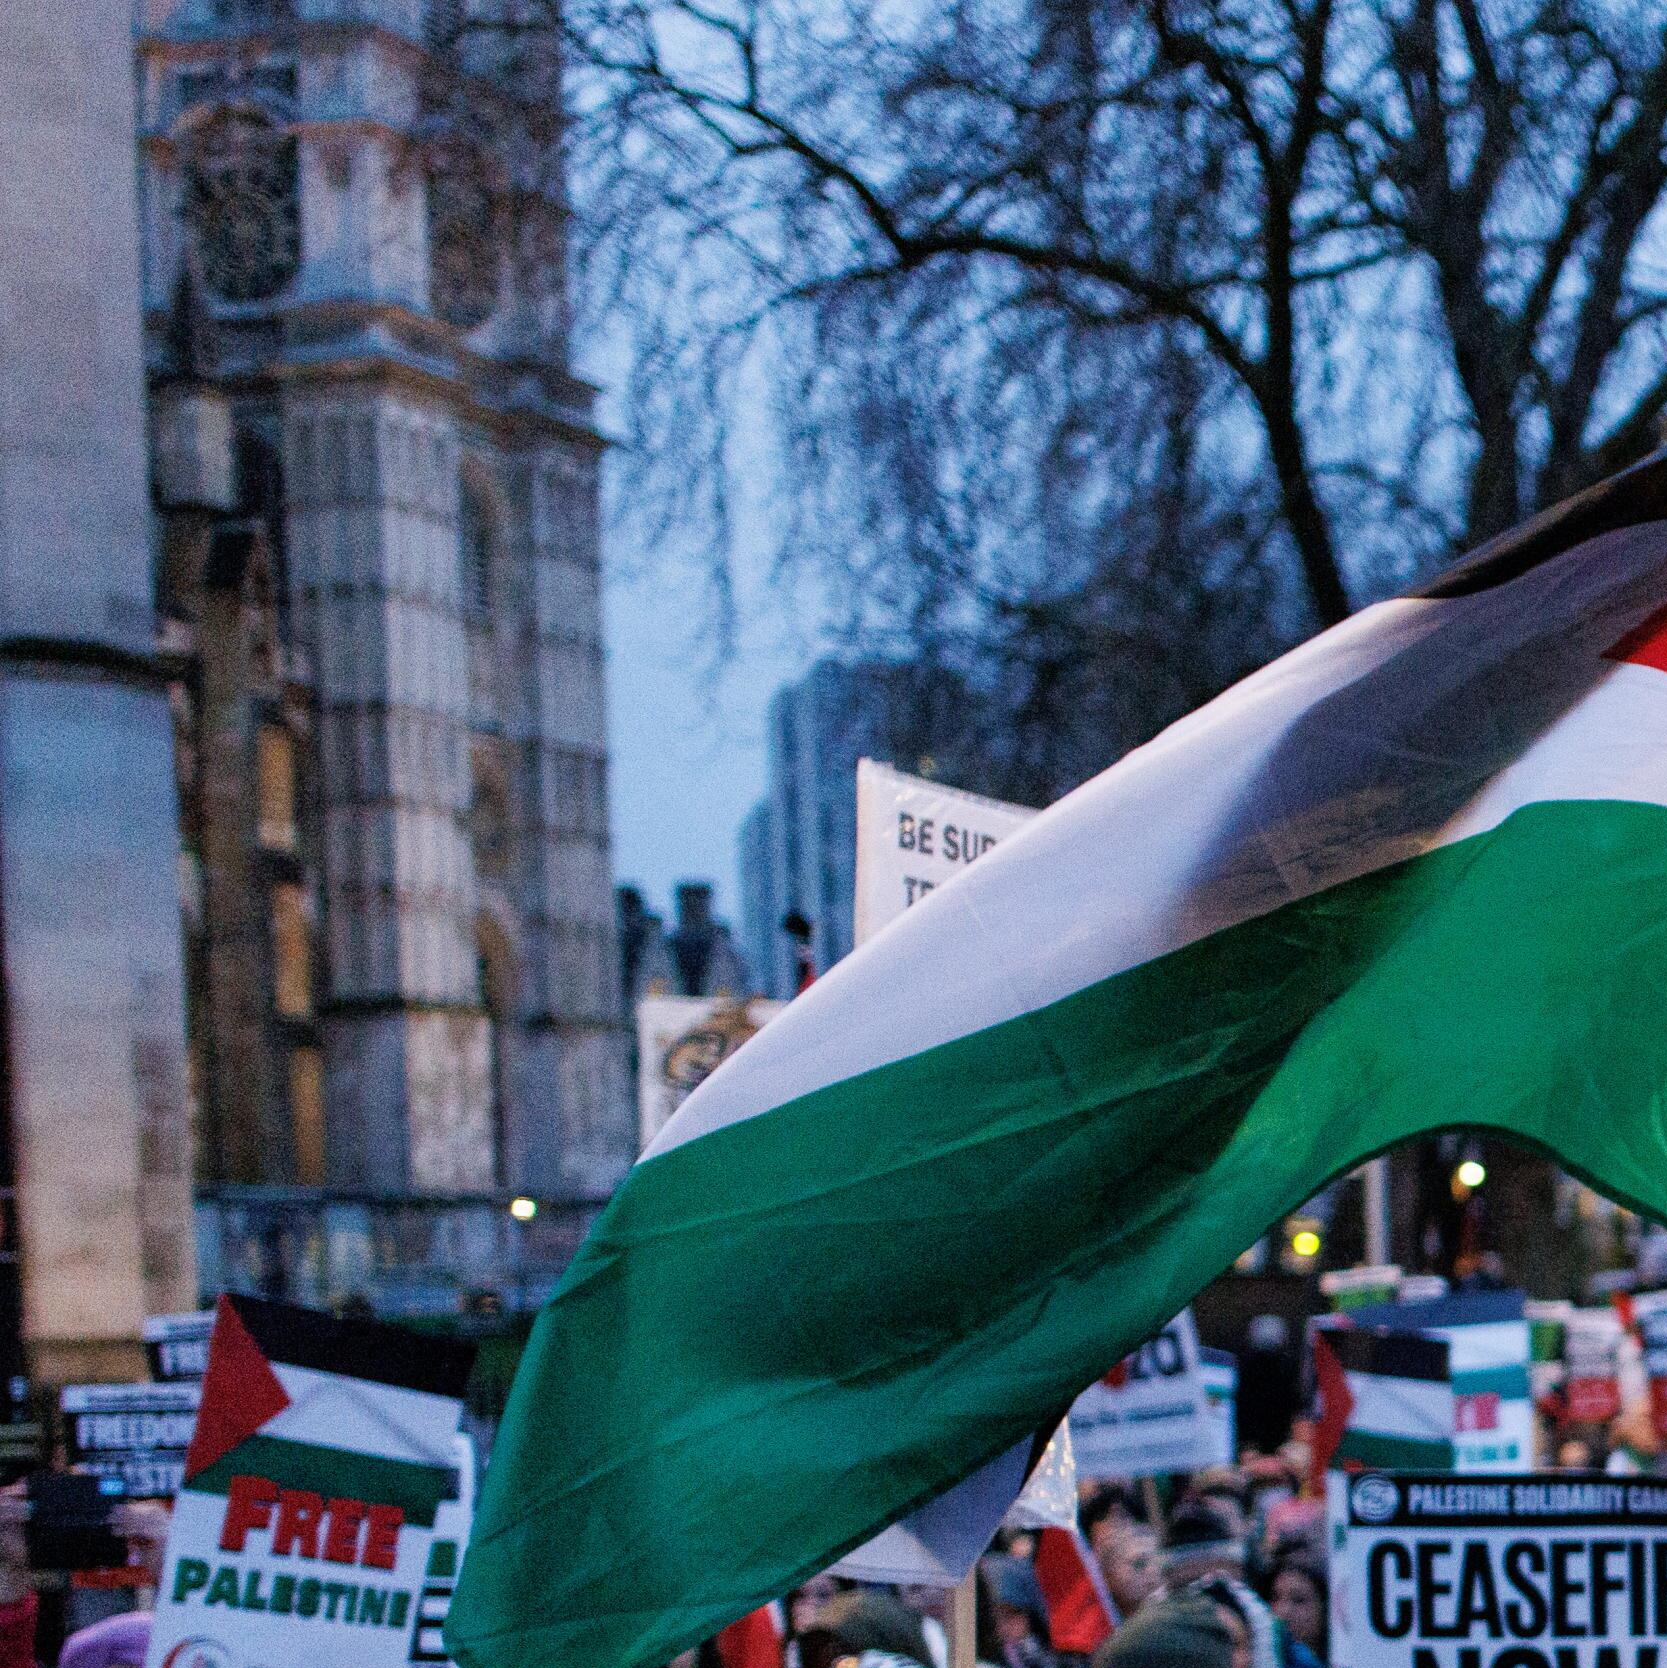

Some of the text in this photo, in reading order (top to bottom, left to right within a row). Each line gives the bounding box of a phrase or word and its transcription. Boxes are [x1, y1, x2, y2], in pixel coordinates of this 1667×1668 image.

[219, 1475, 405, 1572] FREE
[1408, 1484, 1510, 1516] PALESTINE
[1514, 1484, 1626, 1516] SOLIDARITY
[172, 1556, 412, 1629] PALESTINE
